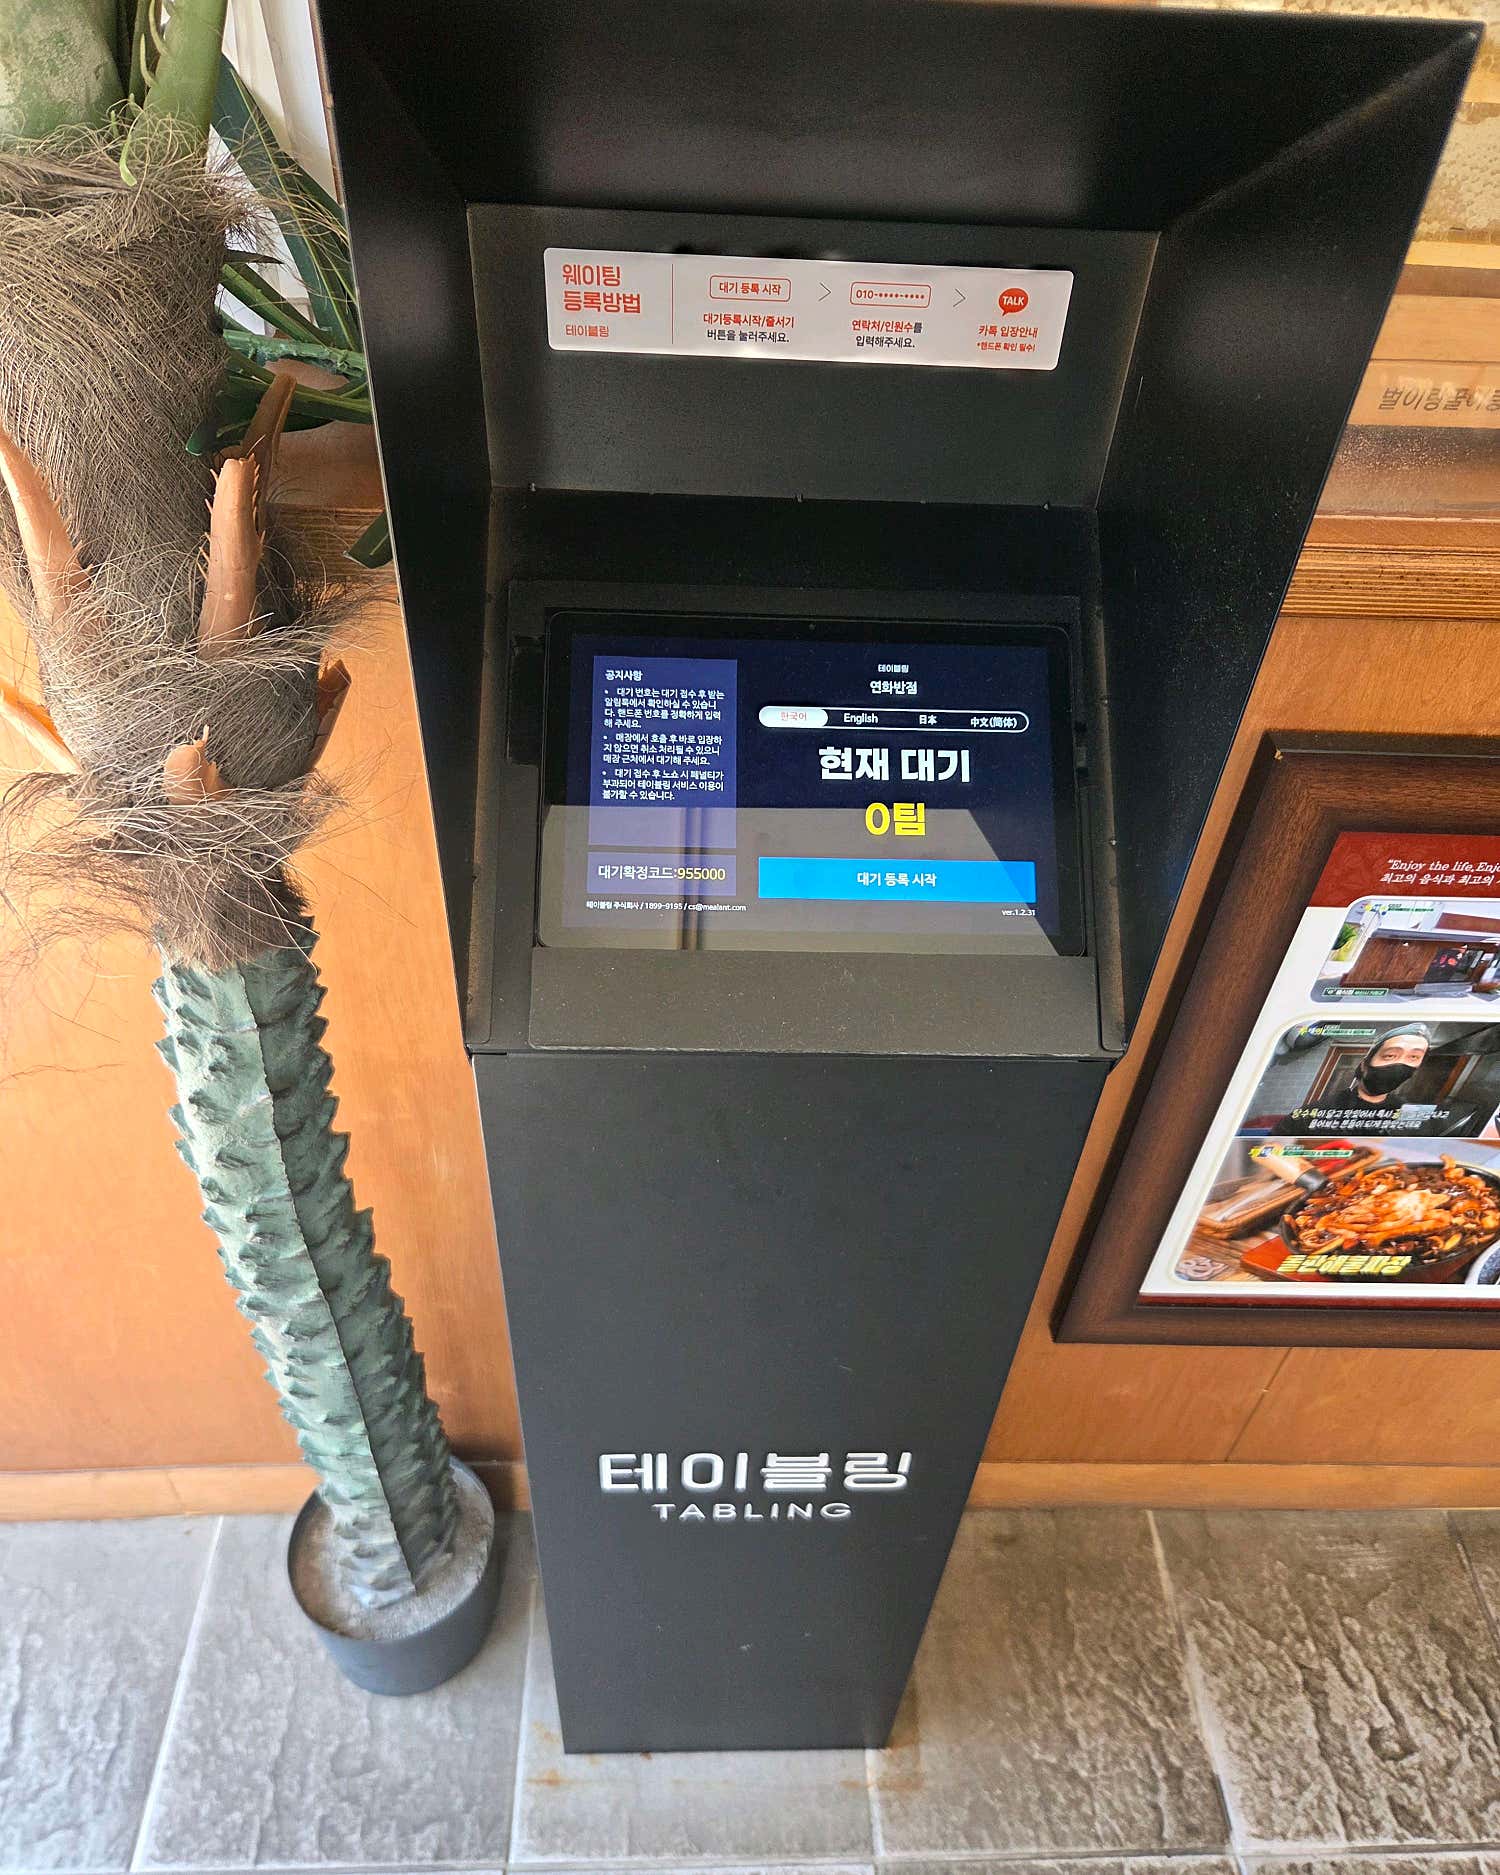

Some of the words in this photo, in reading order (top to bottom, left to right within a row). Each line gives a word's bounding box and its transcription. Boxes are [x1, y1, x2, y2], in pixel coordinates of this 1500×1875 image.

[562, 264, 621, 287] 웨이팅
[719, 281, 739, 294] 대기
[741, 282, 760, 295] 등록
[762, 284, 781, 296] 시작
[563, 290, 641, 314] 등록방법
[1002, 295, 1025, 306] TALK
[703, 313, 795, 328] 대기등록시작/줄서기
[851, 319, 923, 334] 연락처/인원수를
[565, 324, 609, 338] 테이블링
[706, 329, 737, 341] 버튼을
[739, 330, 790, 343] 눌러주세요.
[978, 324, 998, 336] 카톡
[1000, 326, 1039, 339] 입장안내
[856, 335, 915, 349] 입력해주세요.
[1003, 342, 1017, 351] 확인
[605, 670, 643, 682] 공지사항
[617, 687, 634, 697] 대기
[635, 688, 660, 697] 번호는
[661, 688, 678, 699] 대기
[680, 689, 697, 699] 접수
[698, 689, 707, 699] 후
[870, 680, 918, 695] 연화반점
[647, 698, 680, 709] 확인하실
[681, 699, 691, 709] 수
[692, 700, 717, 710] 있습니
[604, 708, 616, 717] 다.
[644, 709, 669, 719] 번호를
[670, 710, 703, 720] 정확하게
[780, 711, 807, 721] 한국어
[843, 713, 878, 724] English
[919, 715, 938, 725] 日本
[604, 718, 613, 728] 해
[614, 719, 642, 729] 주세요.
[615, 733, 649, 743] 매장에서
[668, 734, 678, 744] 후
[678, 735, 697, 744] 바로
[697, 735, 723, 745] 입장하
[603, 744, 612, 753] 지
[613, 744, 639, 754] 않으면
[640, 745, 658, 754] 취소
[685, 745, 694, 755] 수
[695, 746, 720, 756] 있으니
[621, 754, 655, 765] 근처에서
[656, 755, 682, 765] 대기해
[683, 756, 711, 766] 주세요.
[818, 746, 890, 781] 현재
[901, 749, 971, 783] 대기
[615, 768, 632, 778] 대기
[634, 769, 651, 779] 접수
[652, 769, 661, 779] 후
[680, 770, 689, 780] 시
[602, 779, 636, 789] 부과되어
[637, 780, 671, 790] 테이블링
[672, 781, 698, 791] 서비스
[698, 781, 724, 792] 이용이
[629, 790, 638, 800] 수
[639, 790, 675, 801] 있습니다.
[865, 802, 926, 836] 0팀
[598, 865, 726, 880] 대기확정코드:955000
[1429, 861, 1449, 871] the
[856, 872, 882, 885] 대기
[884, 872, 909, 886] 등록
[912, 873, 937, 887] 시작
[1380, 873, 1417, 884] 최고의
[1419, 873, 1455, 885] 음식과
[1458, 874, 1495, 886] 최고의
[613, 901, 639, 910] 주식회사
[599, 1452, 912, 1493] 테이블링
[652, 1502, 851, 1521] TABLING
